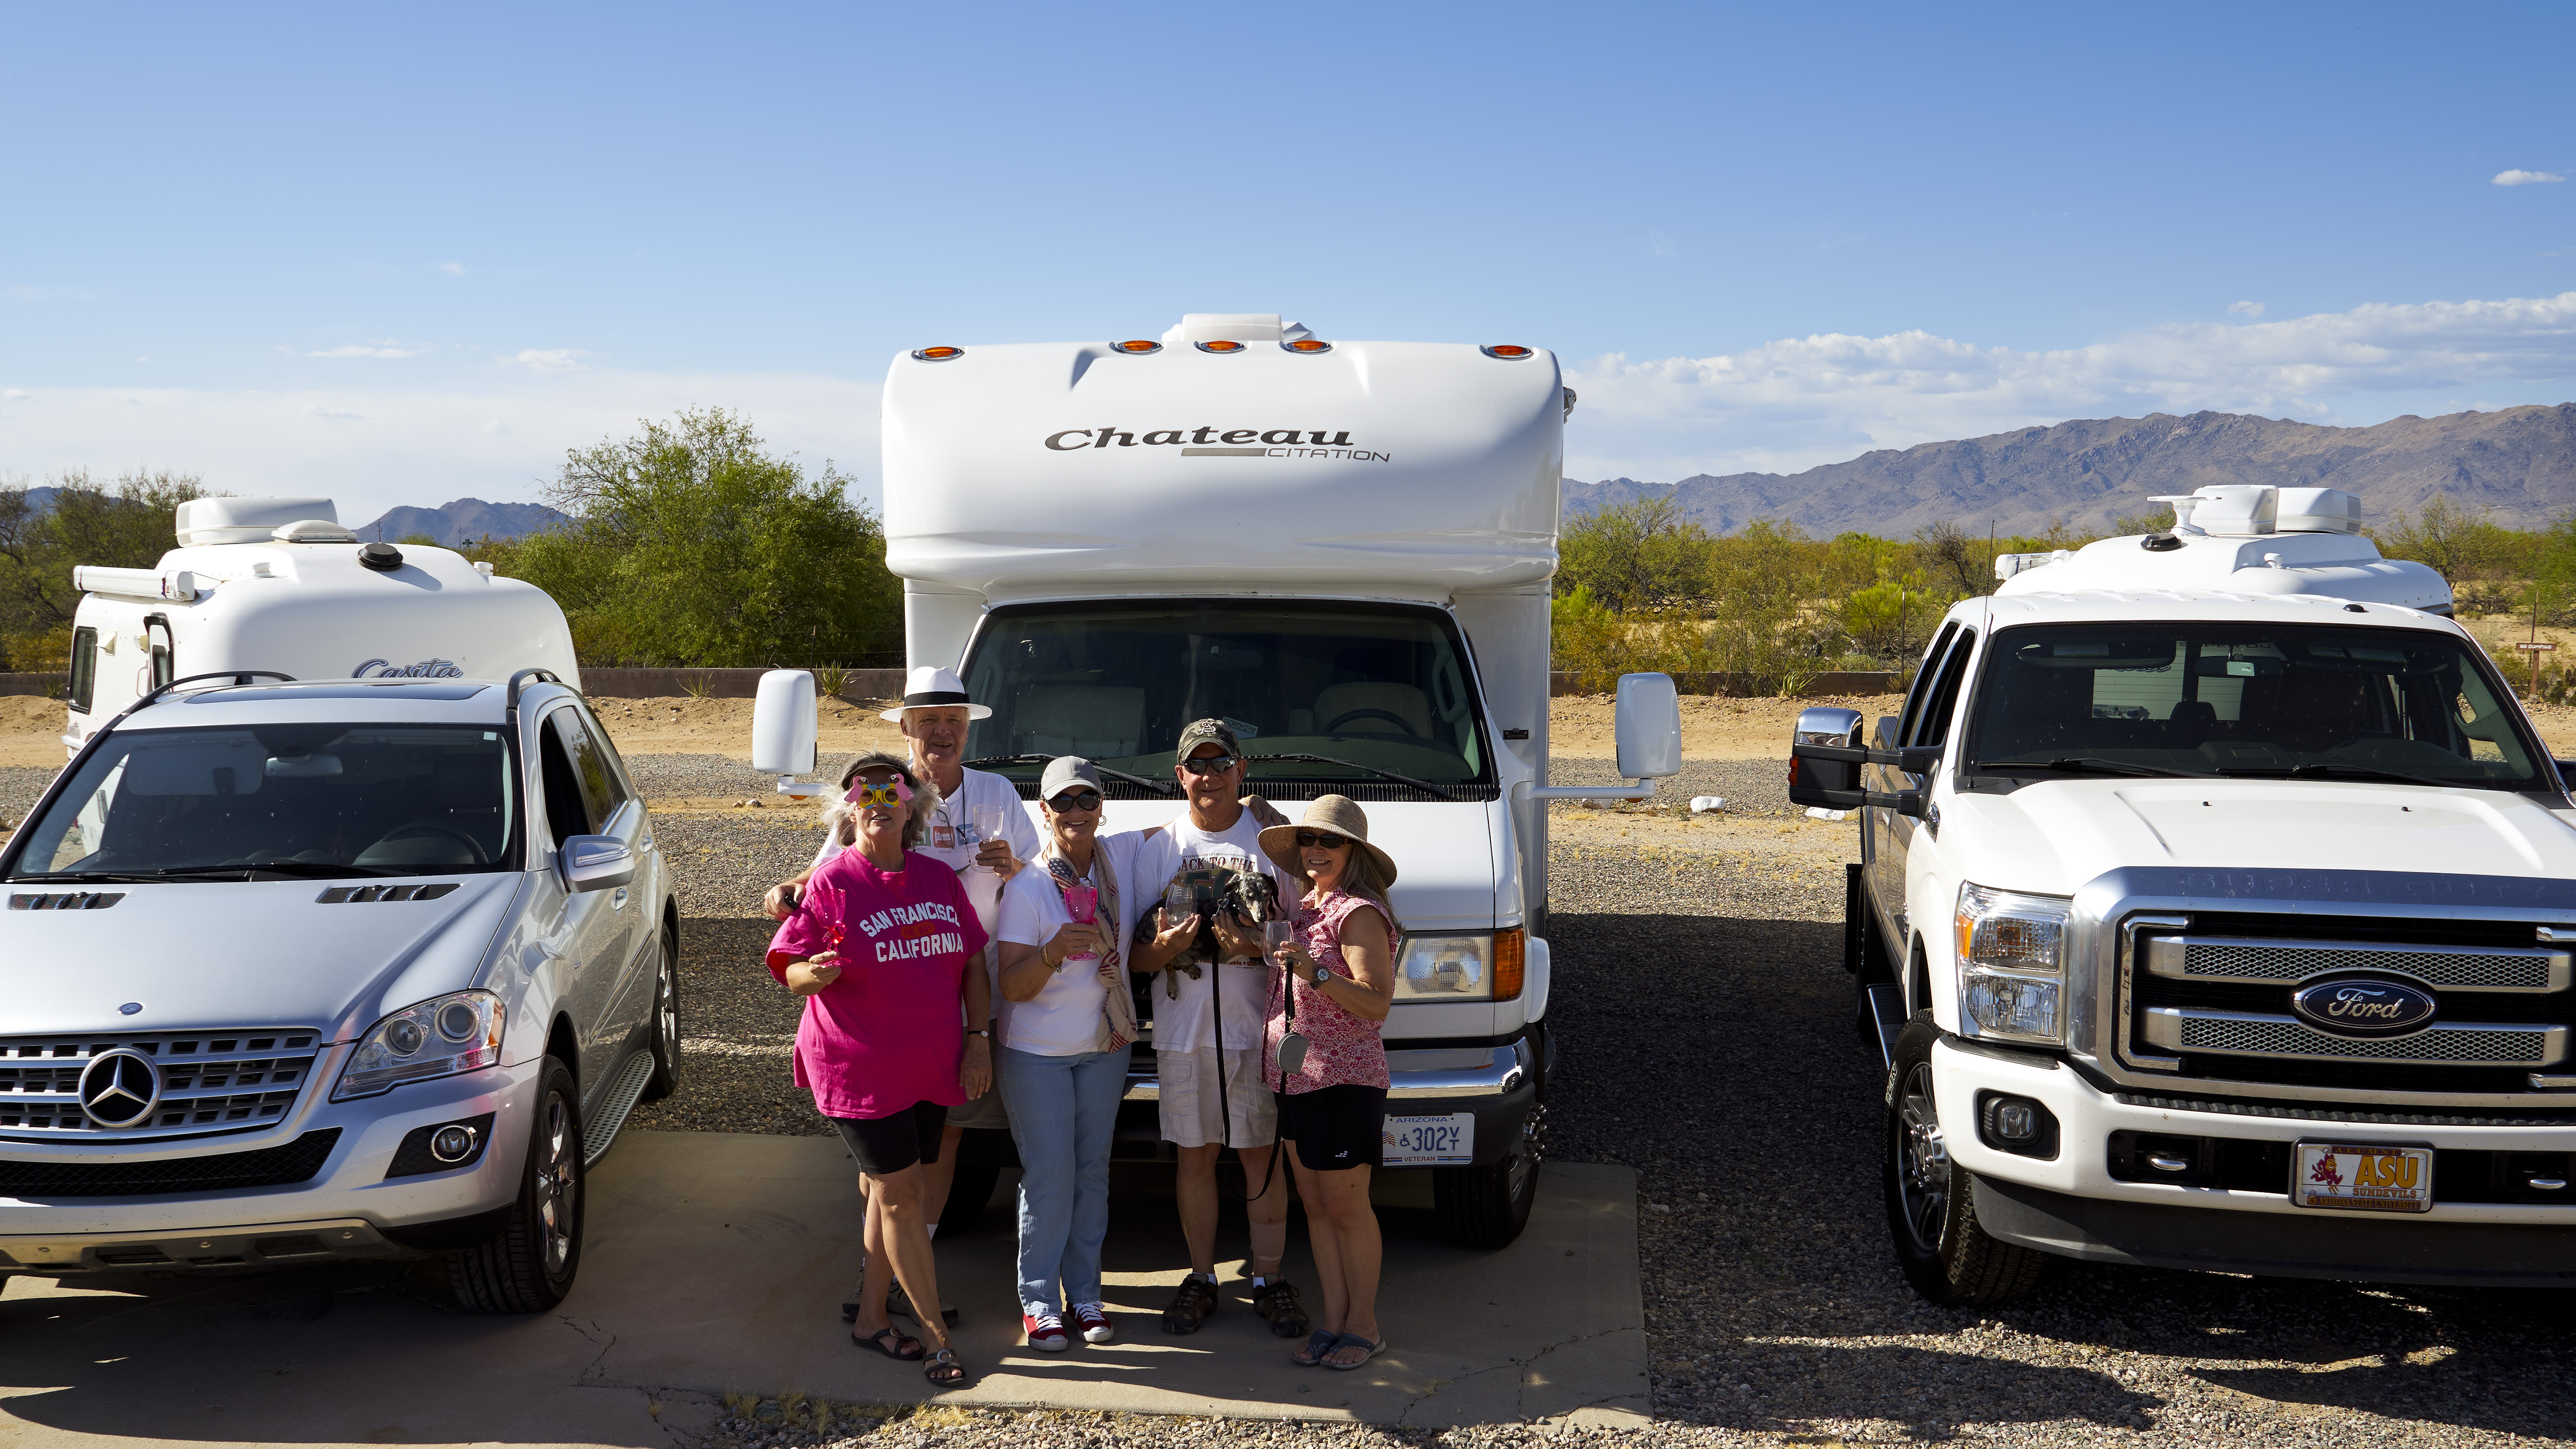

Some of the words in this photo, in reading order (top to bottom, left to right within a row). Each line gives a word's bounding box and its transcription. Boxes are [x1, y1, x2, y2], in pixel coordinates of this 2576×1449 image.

[1045, 425, 1354, 451] Chateau
[1267, 447, 1390, 463] CITATION
[351, 658, 464, 679] Casita
[1177, 857, 1205, 872] ACK
[1210, 857, 1226, 869] TO
[1231, 857, 1255, 872] THE
[859, 911, 894, 937] SAN
[875, 933, 964, 963] CALIFORNIA
[2328, 987, 2404, 1018] Ford
[1412, 1127, 1448, 1152] 302
[2336, 1147, 2396, 1155] ALUMNI
[2354, 1155, 2419, 1189] ASU
[2320, 1196, 2350, 1207] ARIZONA
[2351, 1198, 2374, 1208] STATE
[2375, 1200, 2419, 1210] UNIVERSITY
[2353, 1187, 2417, 1199] SUNDEVILS
